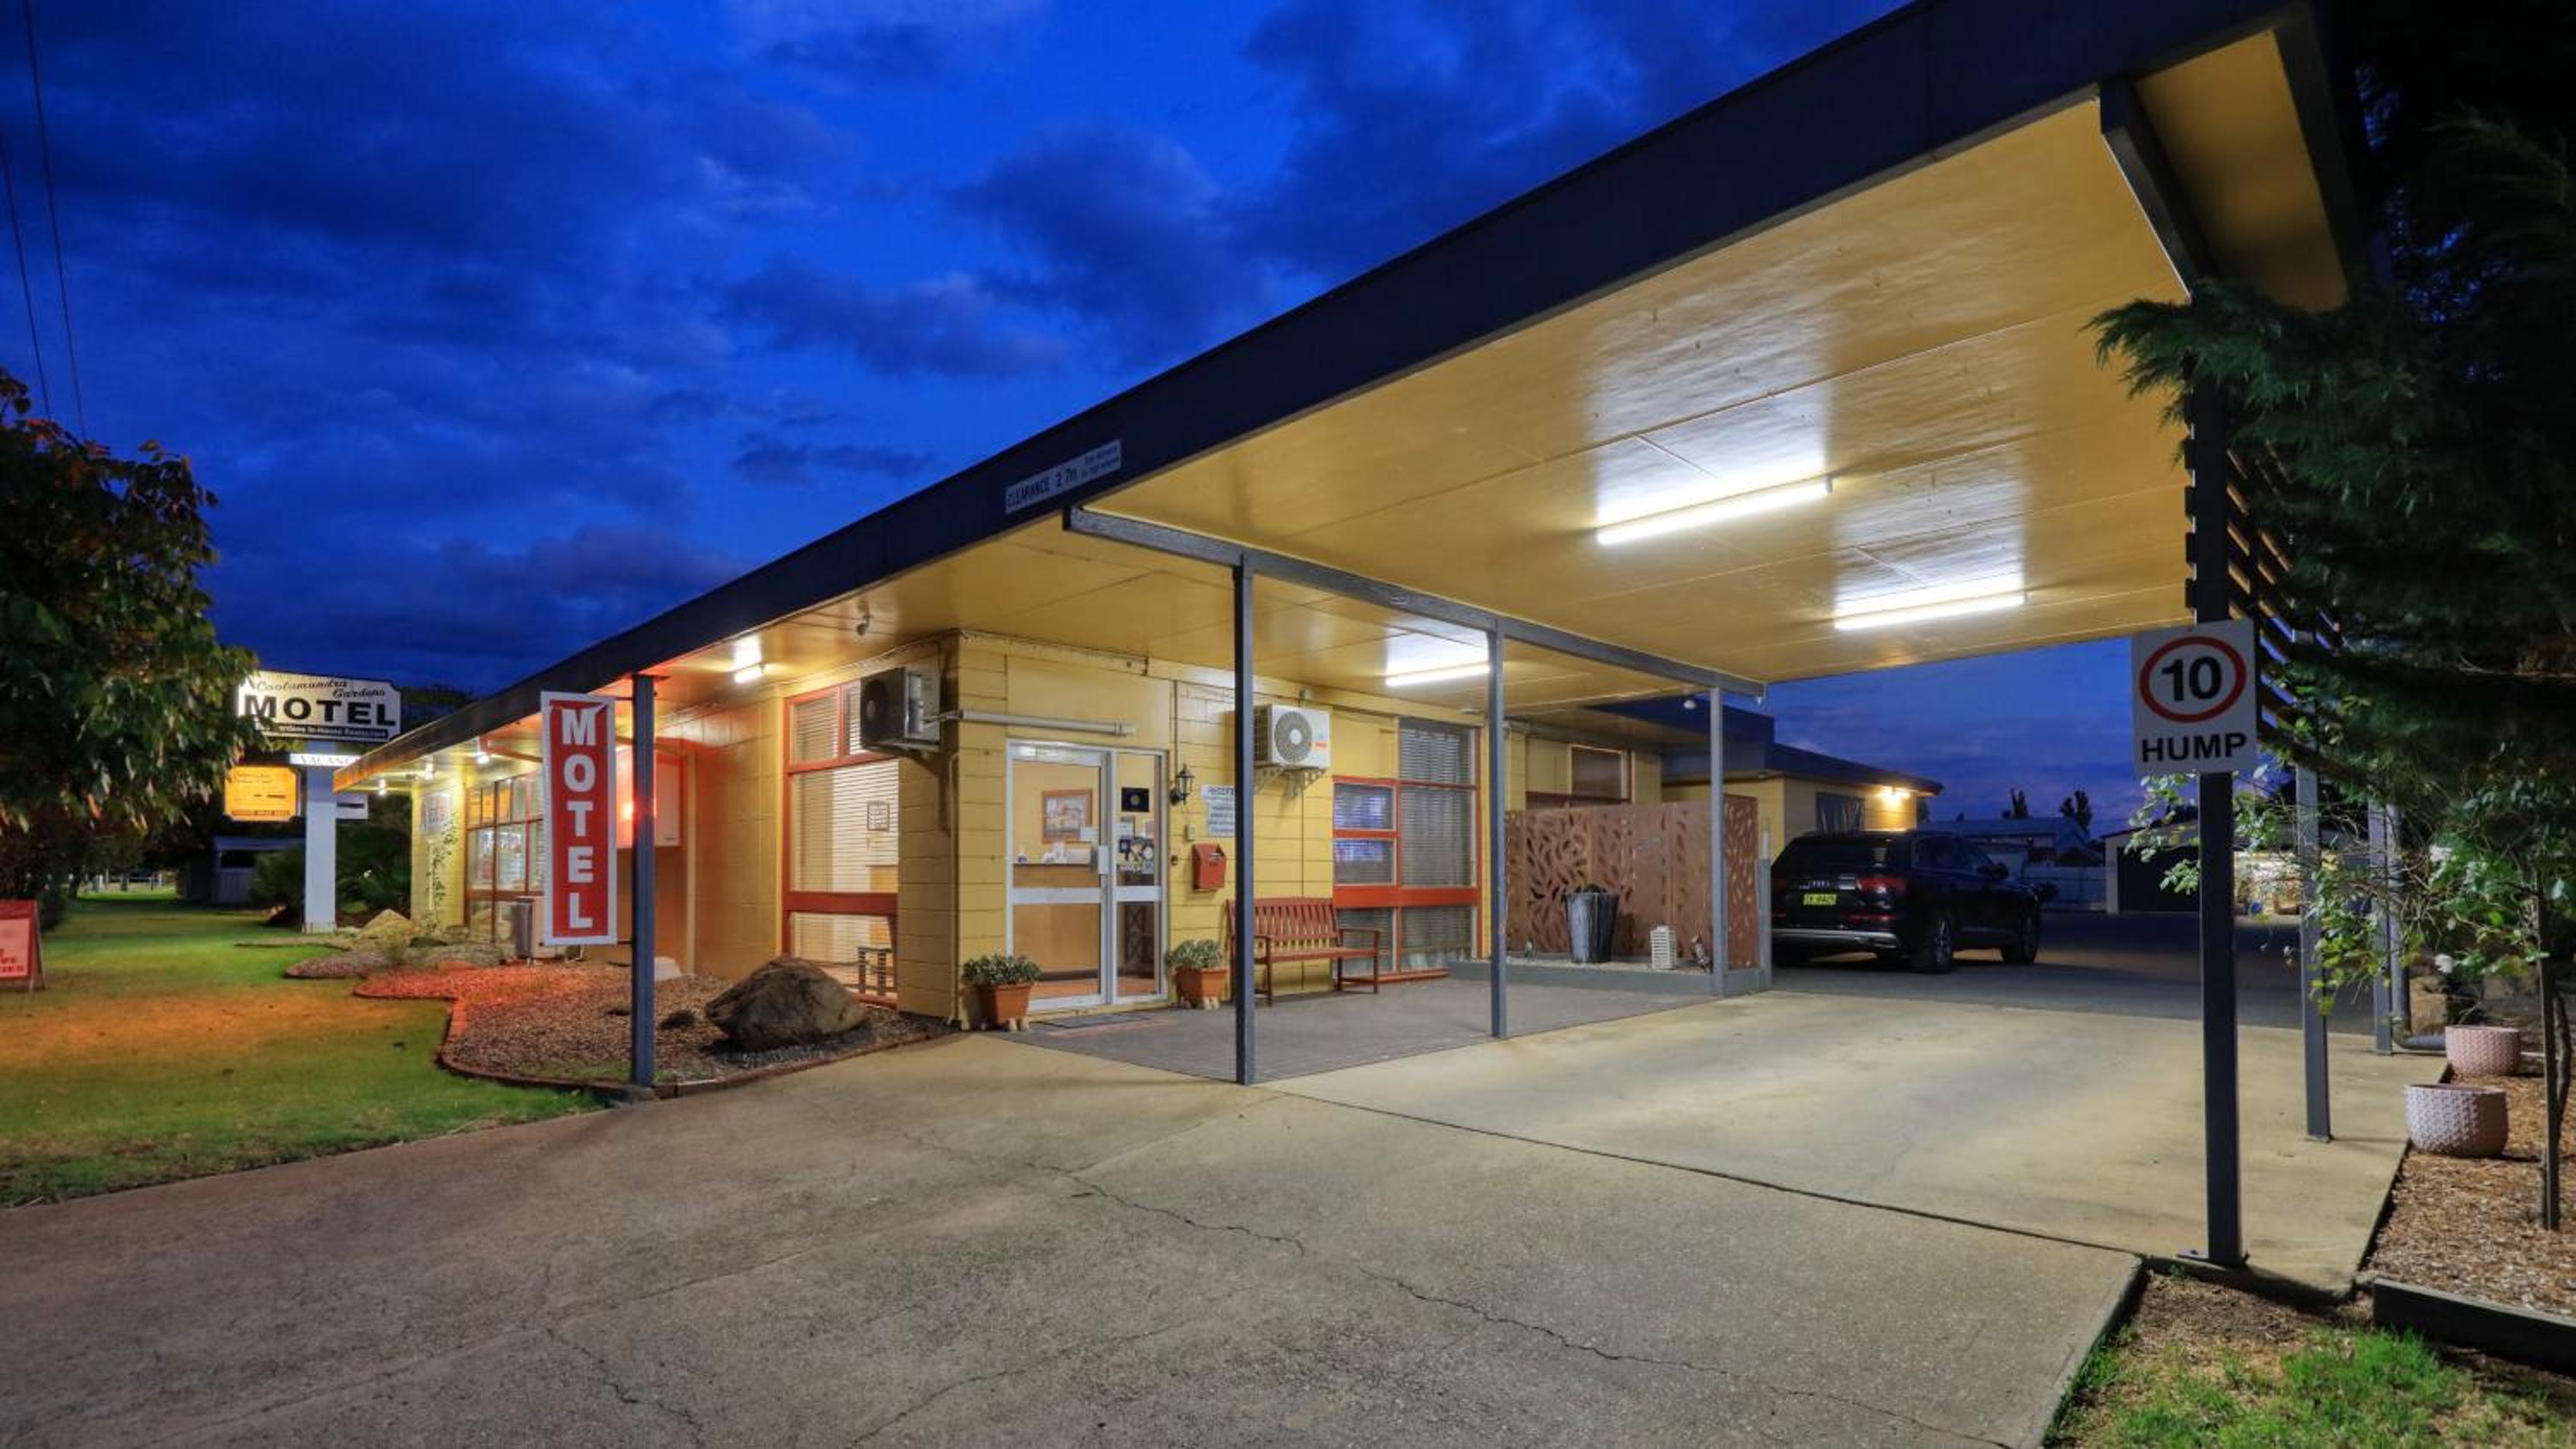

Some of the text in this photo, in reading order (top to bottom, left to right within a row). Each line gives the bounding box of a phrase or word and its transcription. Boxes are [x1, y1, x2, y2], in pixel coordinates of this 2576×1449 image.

[1007, 477, 1049, 506] CLEARANCE
[257, 679, 348, 693] Cootamundra
[332, 688, 386, 699] Gardens
[2161, 656, 2222, 702] 10
[246, 694, 396, 726] MOTEL
[2142, 732, 2247, 763] HUMP
[562, 708, 597, 931] MOTEL
